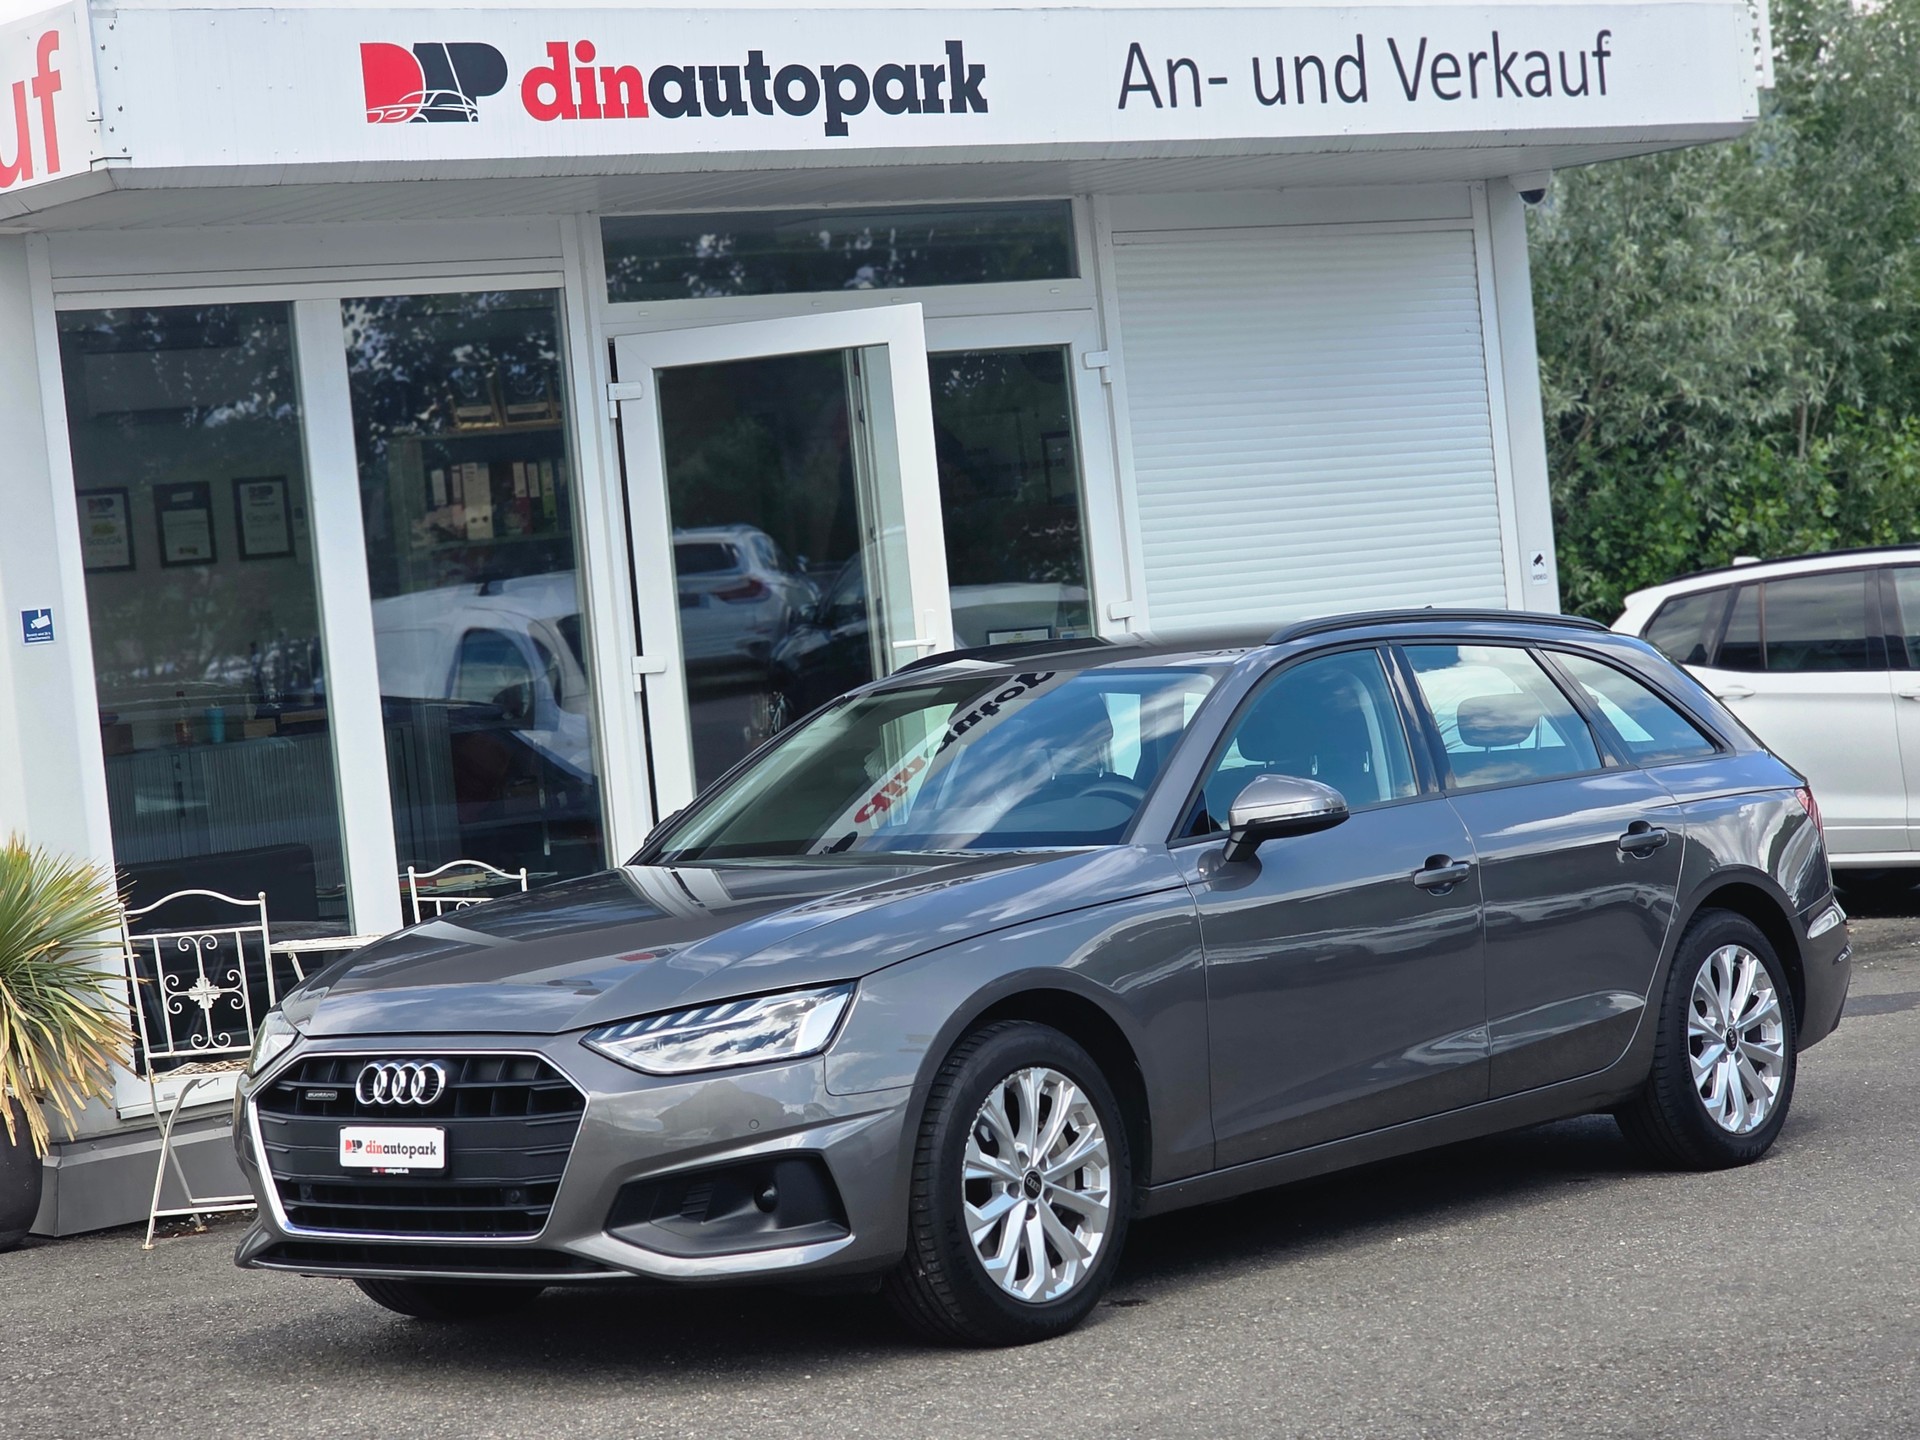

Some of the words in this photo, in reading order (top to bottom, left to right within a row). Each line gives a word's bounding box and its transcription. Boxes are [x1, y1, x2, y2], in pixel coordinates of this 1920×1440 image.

[520, 39, 989, 137] dinautopark
[1117, 42, 1228, 110] An-
[1252, 33, 1368, 107] und
[1386, 29, 1612, 102] Verkauf
[1532, 573, 1548, 581] VIDEO
[365, 1140, 437, 1159] dinautopark
